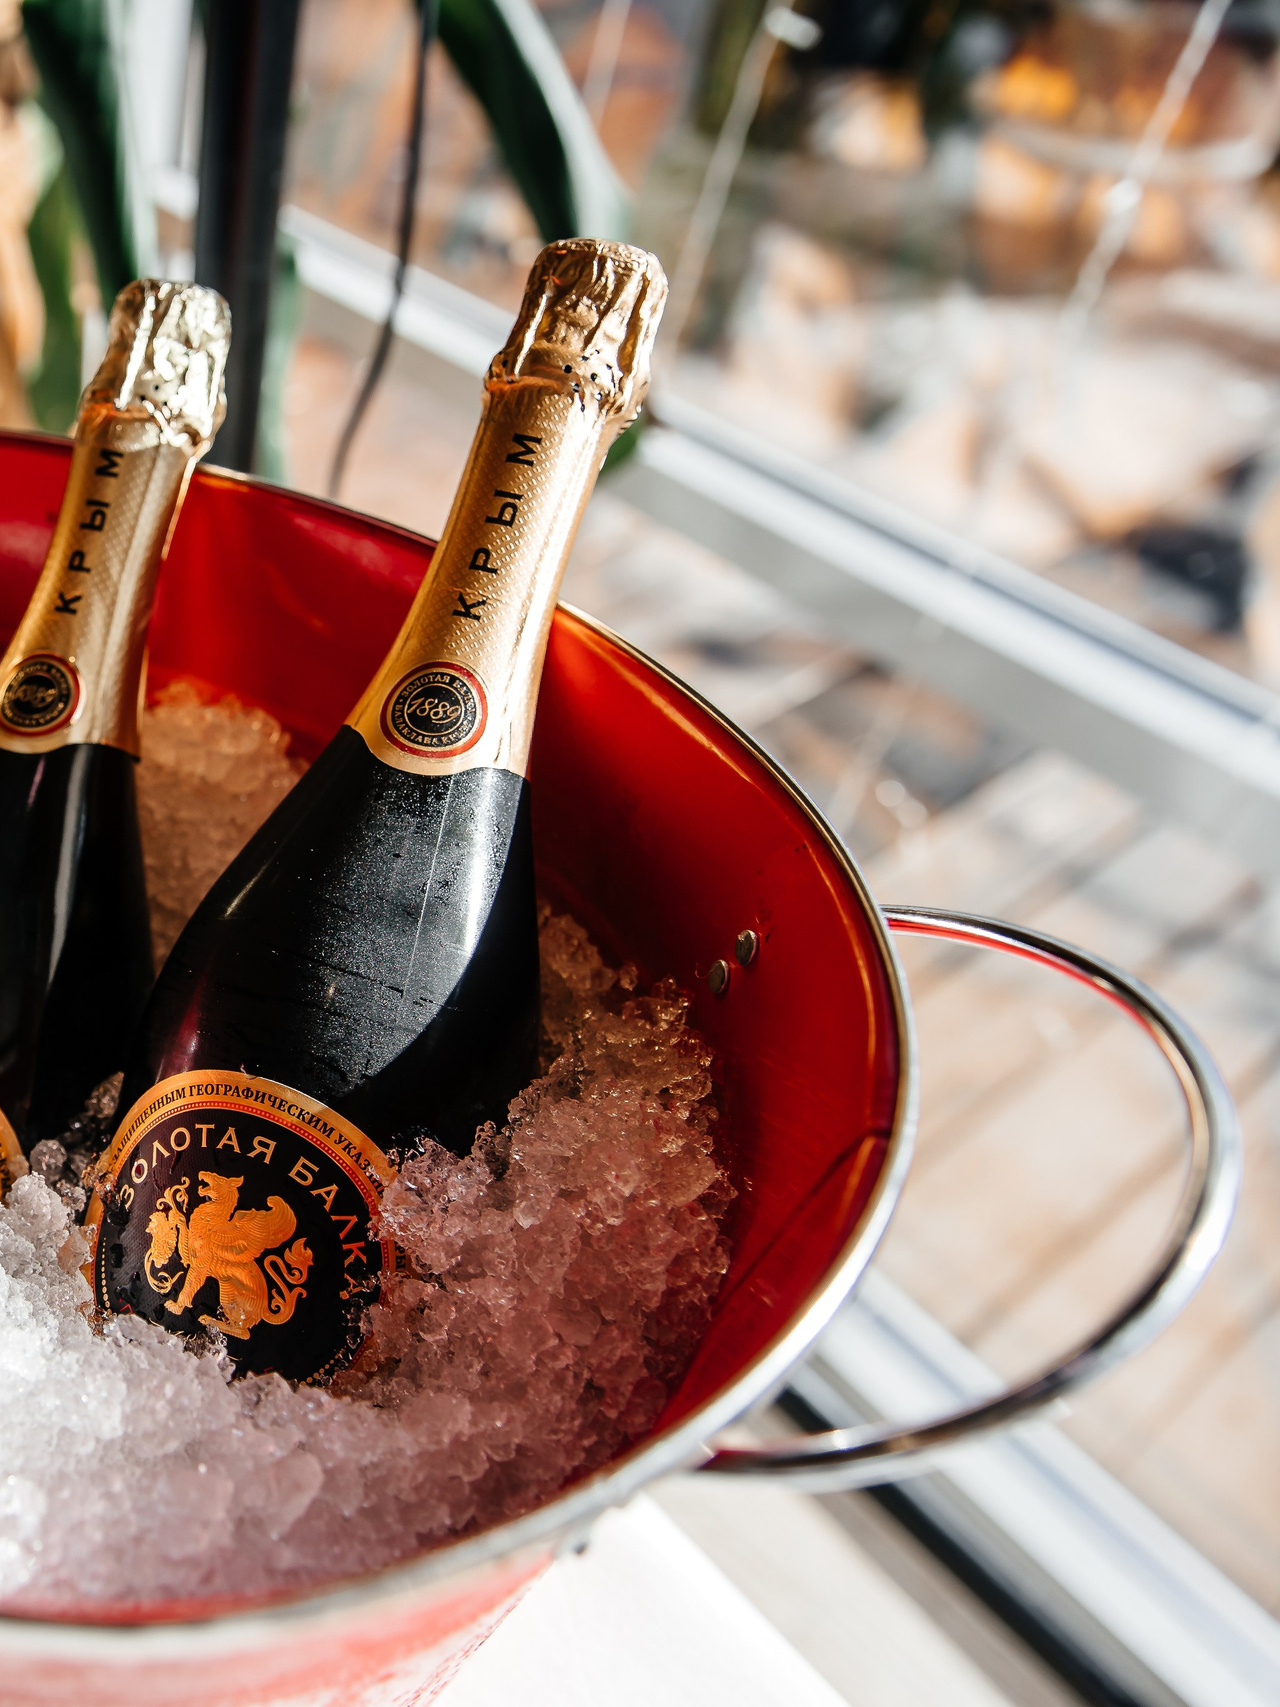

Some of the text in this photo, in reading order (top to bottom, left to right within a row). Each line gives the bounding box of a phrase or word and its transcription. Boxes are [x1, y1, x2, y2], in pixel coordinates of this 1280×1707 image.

[55, 448, 124, 615] КРЫМ
[453, 433, 542, 621] КРЫМ
[394, 704, 439, 746] БАЛАКЛАВА
[401, 674, 451, 698] ЗОЛОТАЯ
[407, 697, 461, 723] 1889
[111, 1086, 187, 1165] ЗАЩИЩЕННЫМ
[188, 1083, 335, 1139] ГЕОГРАФИЧЕСКИМ
[120, 1123, 368, 1300] ЗОЛОТАЯ БАЛКА
